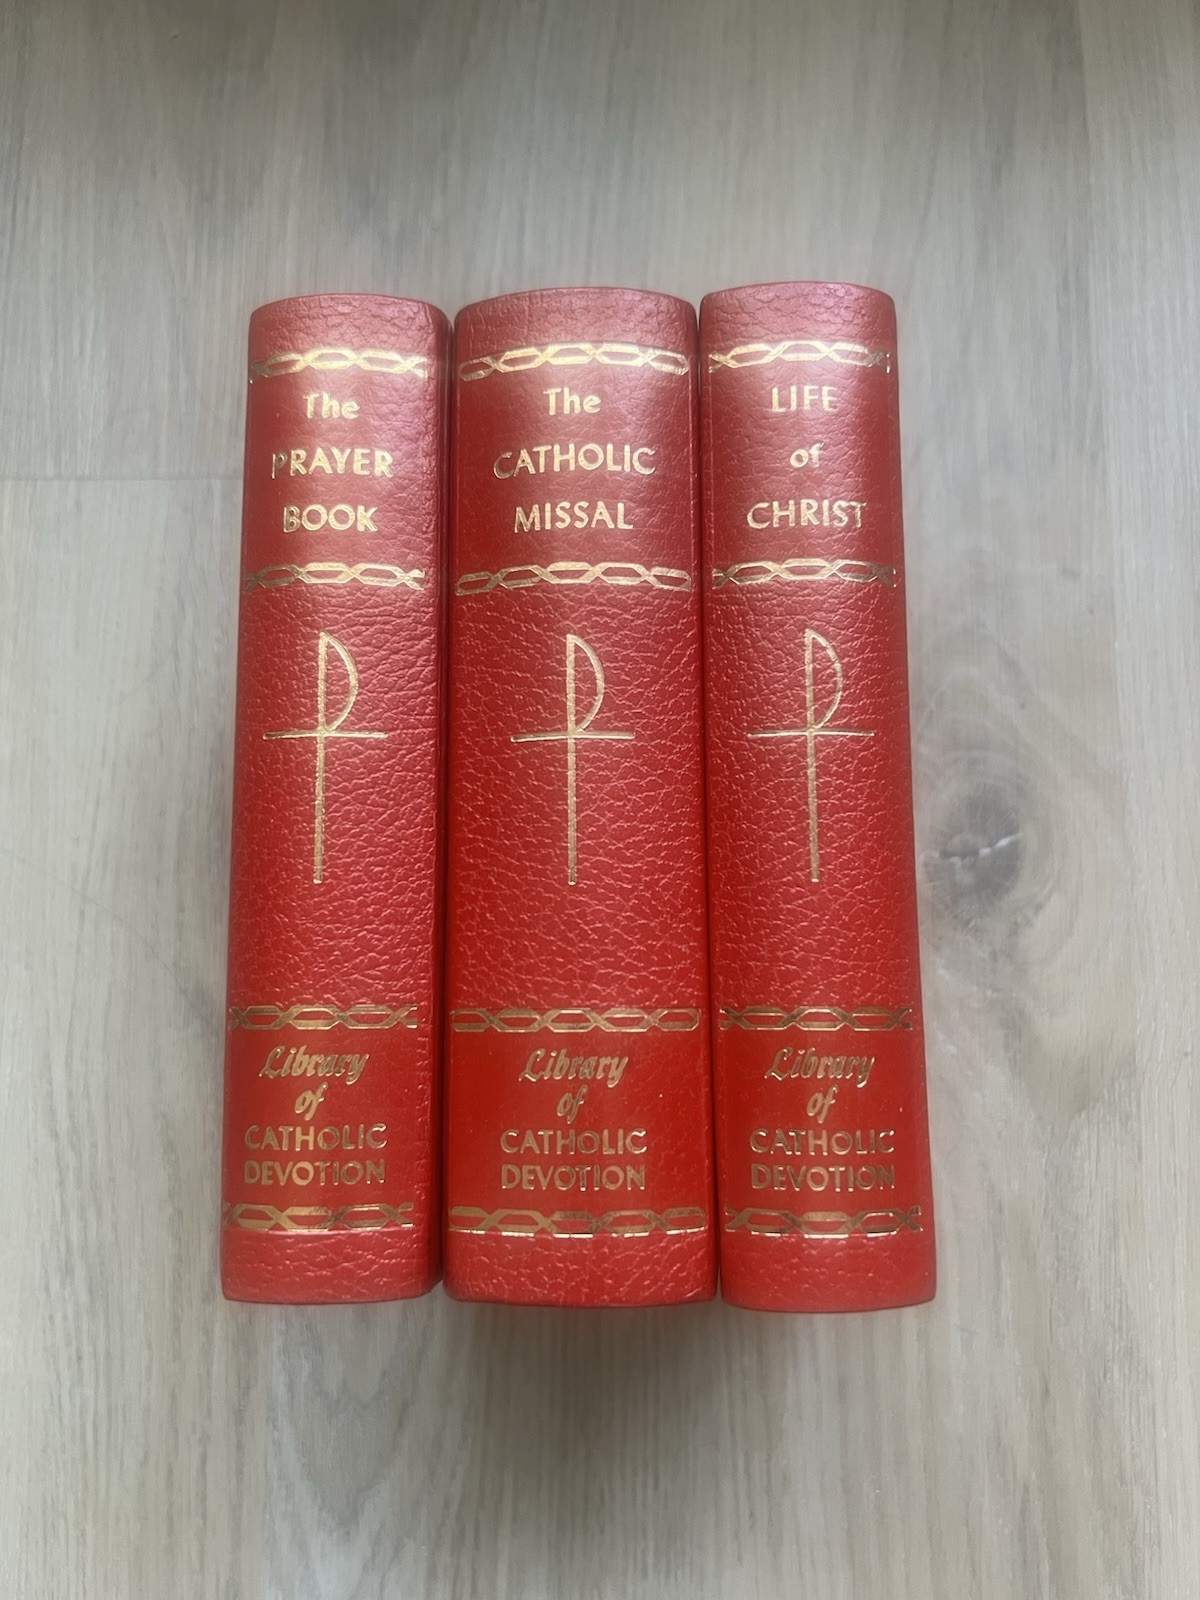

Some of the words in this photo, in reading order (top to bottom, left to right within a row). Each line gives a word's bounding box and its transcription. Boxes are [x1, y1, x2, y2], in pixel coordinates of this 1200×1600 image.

[303, 391, 360, 419] The
[543, 387, 601, 415] The
[771, 385, 839, 413] LIFE
[271, 446, 394, 479] PRAYER
[493, 443, 655, 479] CATHOLIC
[789, 441, 824, 468] of
[283, 503, 379, 533] BOOK
[514, 501, 633, 534] MISSAL
[746, 499, 867, 529] CHRIST
[259, 1045, 369, 1085] Library
[519, 1048, 629, 1088] Library
[764, 1046, 875, 1088] Library
[294, 1082, 328, 1121] of
[556, 1084, 588, 1125] of
[806, 1084, 838, 1124] of
[244, 1123, 388, 1151] CATHOLIC
[500, 1128, 647, 1155] CATHOLIC
[749, 1129, 895, 1155] CATHOLIC
[244, 1159, 386, 1186] DEVOTION
[501, 1164, 646, 1191] DEVOTION
[751, 1163, 895, 1191] DEVOTION
